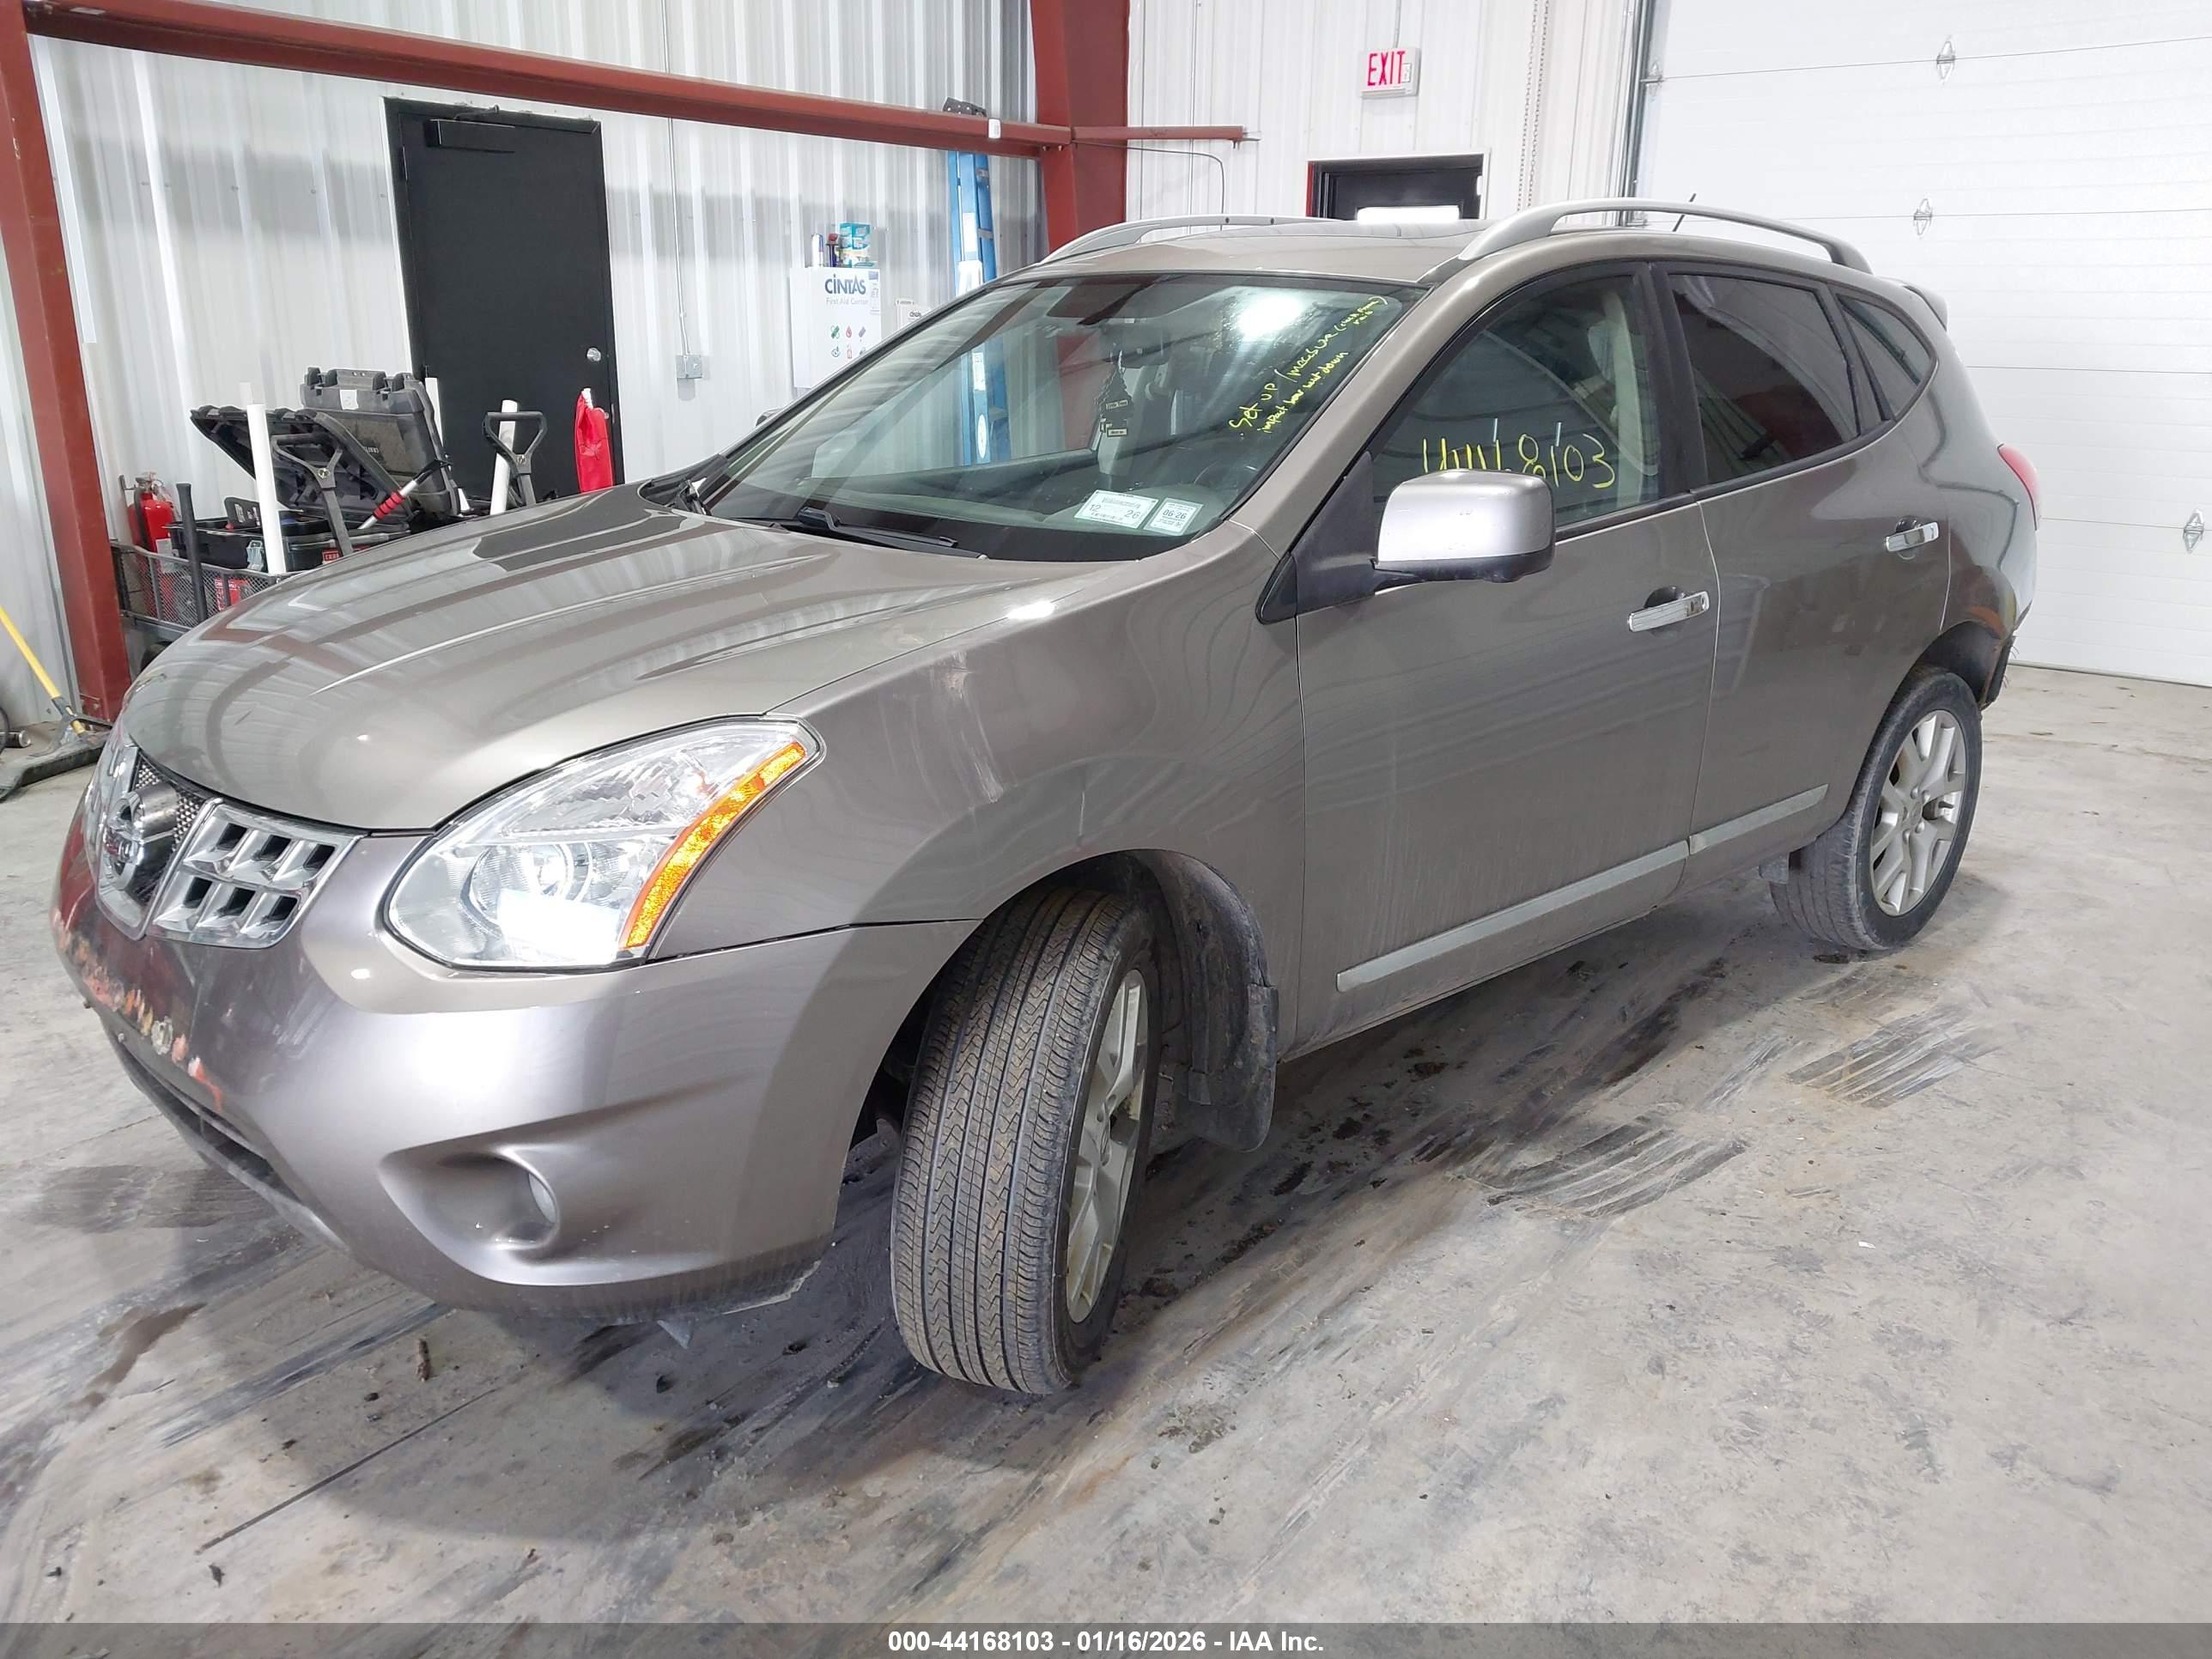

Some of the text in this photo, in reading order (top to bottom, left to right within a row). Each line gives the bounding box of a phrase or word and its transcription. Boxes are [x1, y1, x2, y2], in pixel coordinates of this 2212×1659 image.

[1367, 50, 1406, 87] EXIT
[1089, 503, 1102, 512] 12
[1124, 509, 1141, 520] 26
